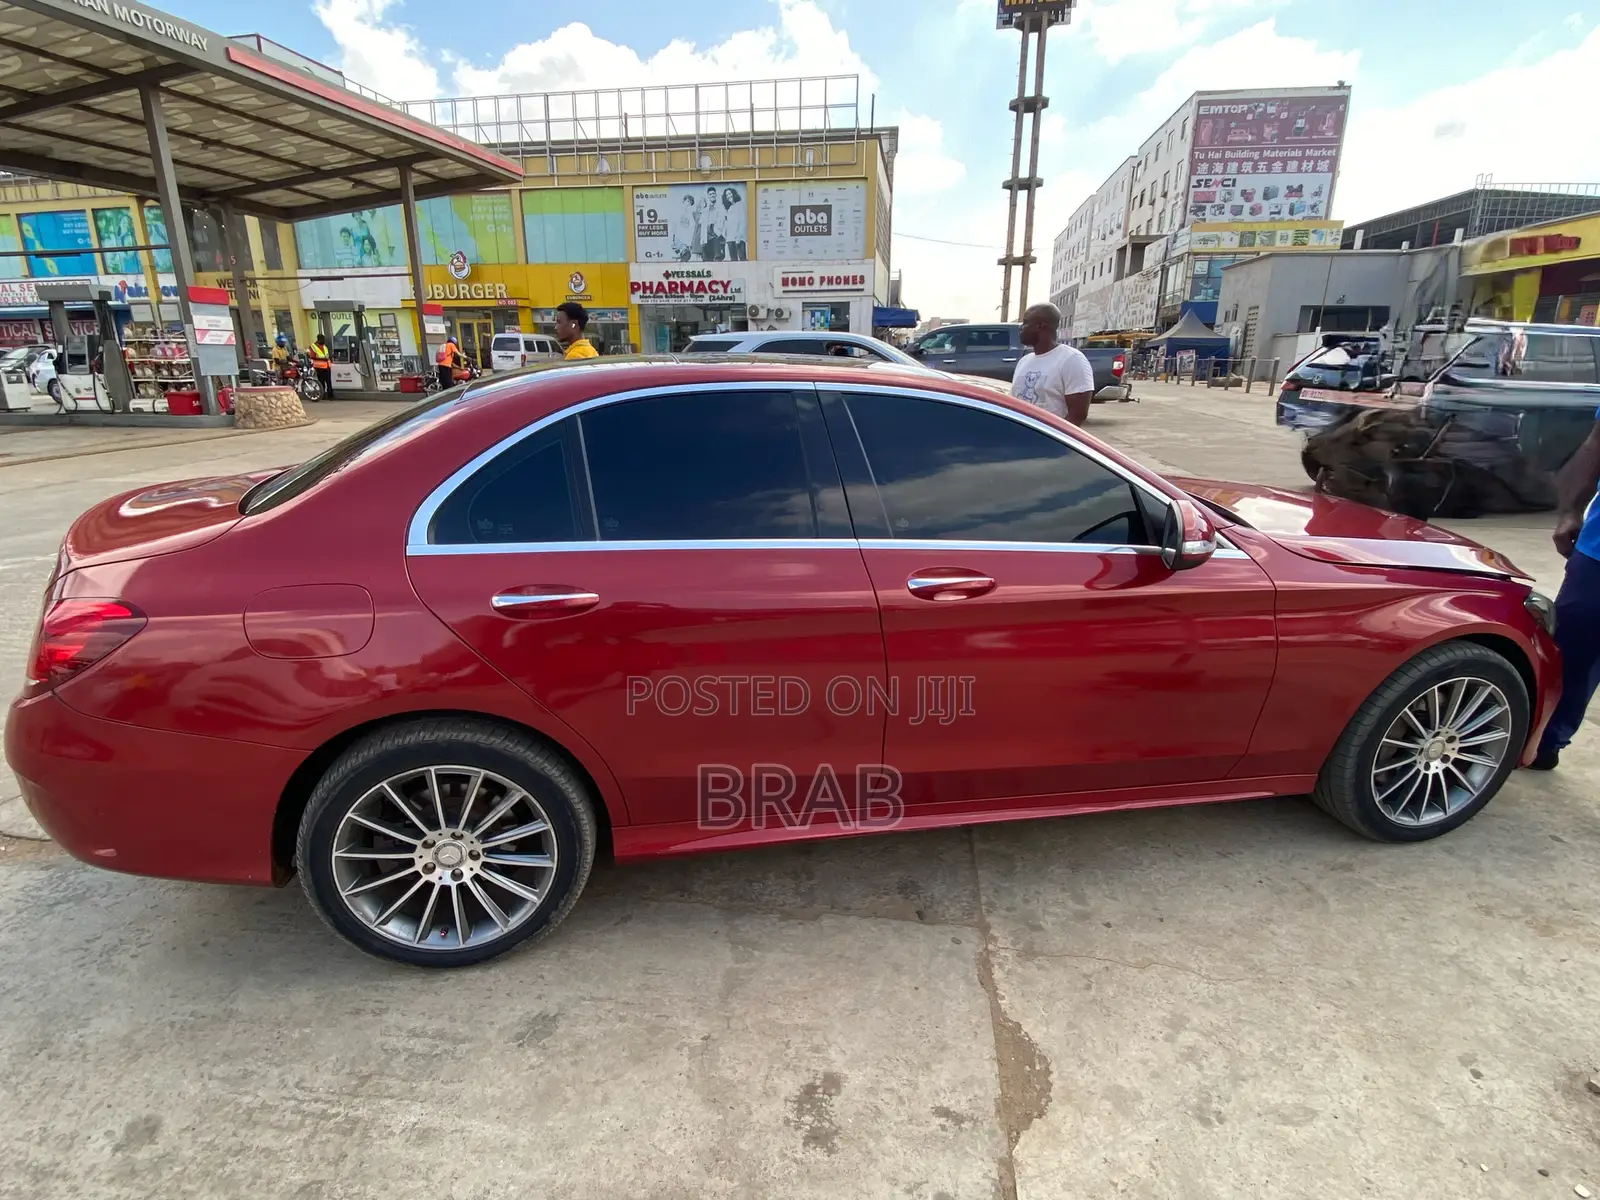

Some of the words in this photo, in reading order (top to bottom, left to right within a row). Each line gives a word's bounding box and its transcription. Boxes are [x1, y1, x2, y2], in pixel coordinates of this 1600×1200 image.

[112, 2, 208, 51] MOTORWAY
[1199, 104, 1248, 115] EMTOP
[1208, 151, 1222, 159] Hai
[1225, 150, 1260, 160] Building
[1263, 149, 1303, 158] Materials
[1305, 148, 1336, 157] Market
[1192, 177, 1237, 189] SENCI
[636, 208, 659, 224] 19
[794, 208, 828, 225] aba
[794, 225, 828, 233] OUTLETS
[819, 275, 865, 286] PHONES
[630, 280, 731, 295] PHARMACY
[709, 294, 736, 302] (24hrs)
